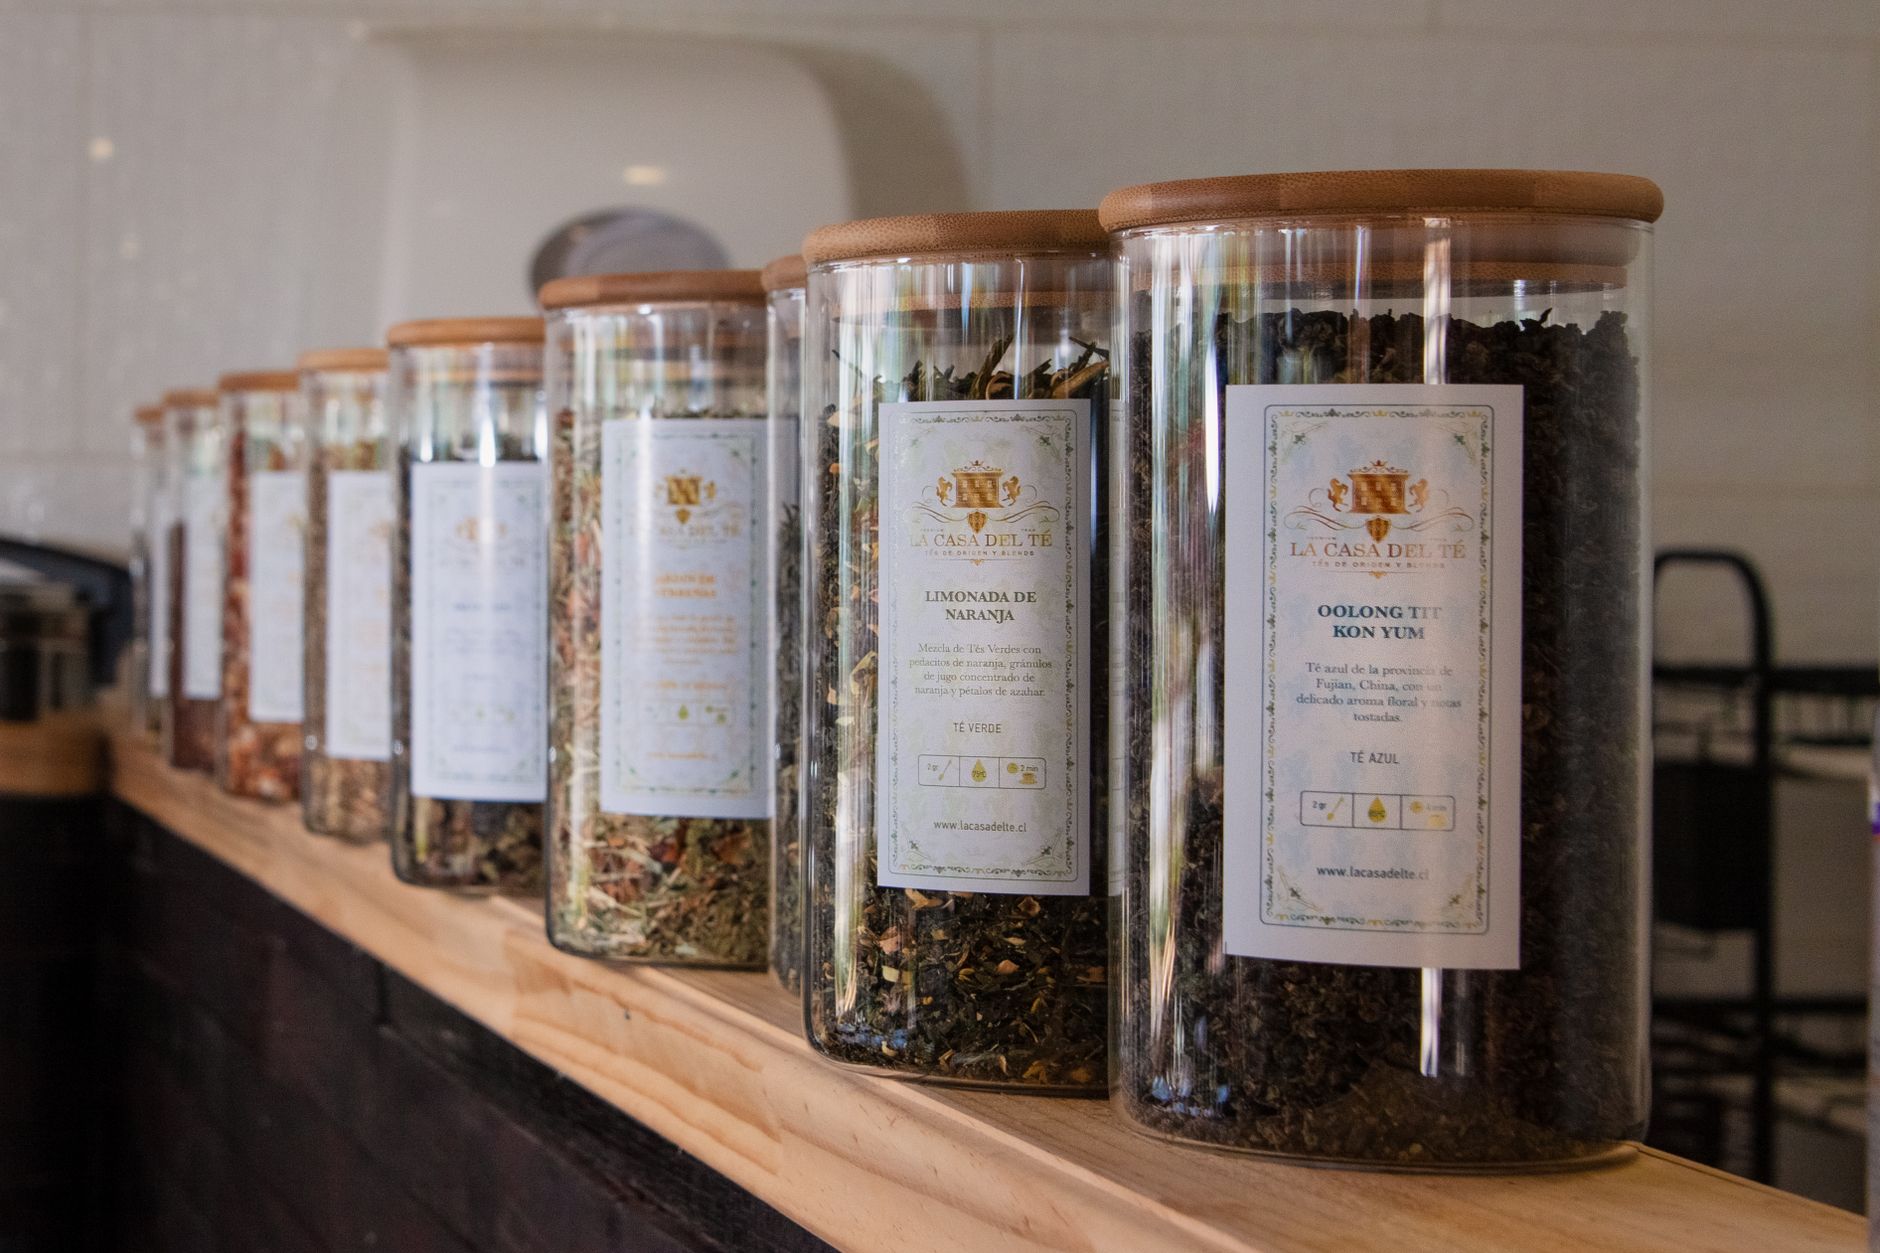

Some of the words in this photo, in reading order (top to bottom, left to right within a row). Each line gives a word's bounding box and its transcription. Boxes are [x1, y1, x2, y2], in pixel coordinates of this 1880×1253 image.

[934, 533, 980, 546] CASA
[985, 534, 1023, 546] DEL
[1028, 529, 1052, 546] TÉ
[1290, 542, 1316, 556] LA
[1324, 543, 1381, 557] CASA
[1388, 544, 1432, 558] DEL
[1440, 538, 1466, 558] TÉ
[926, 590, 1011, 602] LIMONADA
[1014, 592, 1036, 602] DE
[946, 608, 1014, 624] NARANJA
[1318, 604, 1403, 619] OOLONG
[1408, 606, 1442, 620] TIT
[1333, 626, 1376, 639] KON
[1382, 626, 1425, 640] YUM
[918, 644, 950, 654] Mezcla
[953, 644, 964, 654] de
[967, 644, 984, 654] Tés
[987, 644, 1020, 654] Verdes
[952, 658, 964, 667] de
[1009, 658, 1052, 670] gránulos
[1305, 662, 1322, 674] Té
[1325, 662, 1348, 674] azul
[1352, 663, 1366, 674] de
[1368, 664, 1378, 674] la
[924, 672, 934, 681] de
[936, 673, 956, 684] jugo
[960, 673, 1020, 682] concentrado
[1022, 673, 1034, 682] de
[914, 687, 948, 698] naranja
[949, 688, 956, 698] y
[959, 686, 992, 698] pétalos
[995, 687, 1008, 696] de
[1296, 694, 1344, 706] delicado
[1346, 698, 1384, 706] aroma
[1388, 696, 1418, 706] floral
[953, 720, 966, 732] TÉ
[968, 722, 1002, 733] VERDE
[1350, 752, 1364, 764] TÉ
[1368, 752, 1400, 764] AZUL
[934, 820, 1027, 832] www.lacasadelte.cl
[1316, 866, 1430, 880] www.lacasadelte.cl
